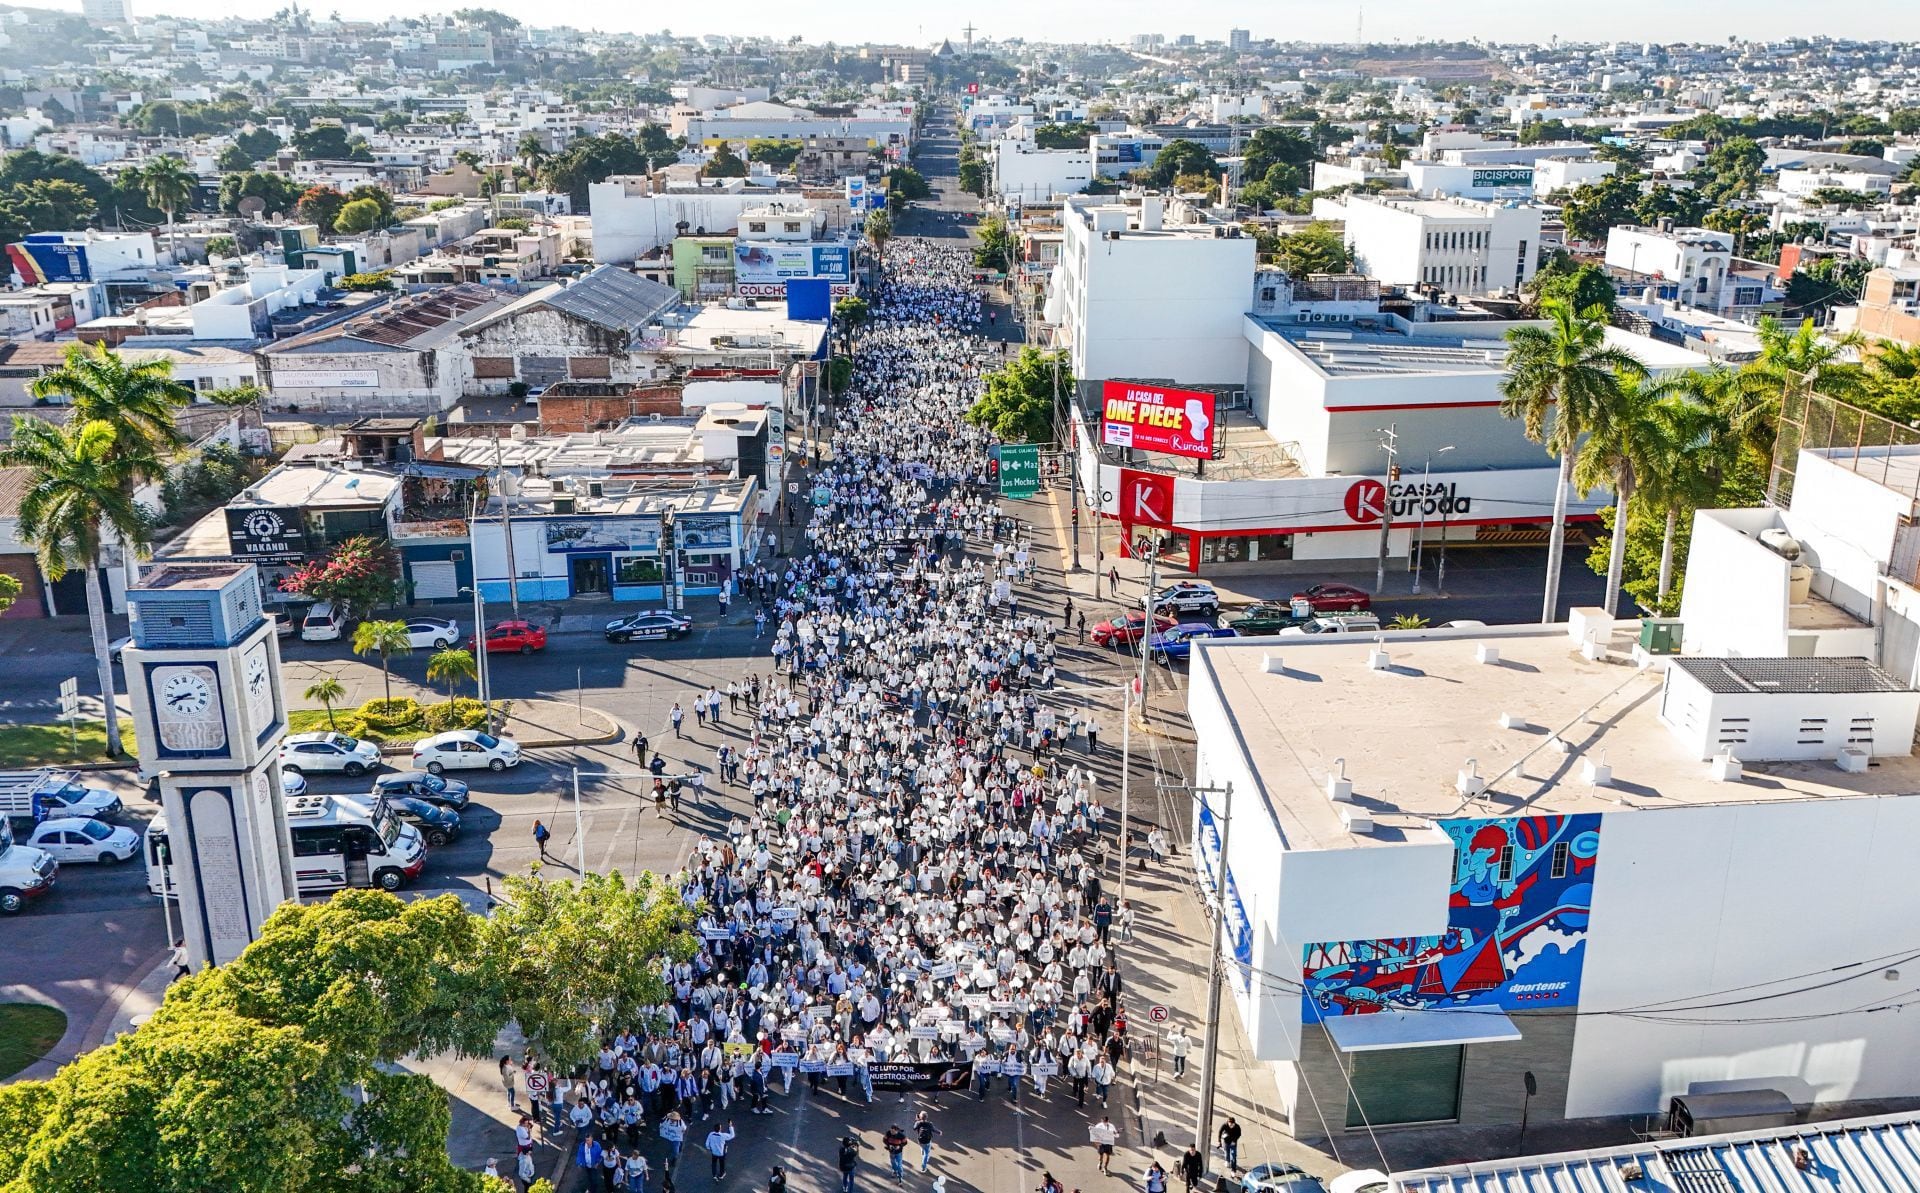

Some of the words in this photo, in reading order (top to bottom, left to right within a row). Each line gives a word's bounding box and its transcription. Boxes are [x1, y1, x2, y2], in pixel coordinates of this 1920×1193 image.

[1473, 170, 1532, 180] BICISPORT
[1127, 389, 1134, 401] LA
[1135, 391, 1152, 403] CASA
[1152, 393, 1165, 405] DEL
[1106, 399, 1136, 423] ONE
[1138, 402, 1184, 429] PIECE
[1172, 436, 1209, 453] Kuroda
[1001, 478, 1013, 486] Los
[1014, 477, 1036, 486] Mochis
[1389, 482, 1445, 498] CASA
[1357, 482, 1471, 519] Kuroda
[246, 543, 289, 552] VAKANDI
[1508, 981, 1567, 993] dportenis
[899, 1065, 915, 1073] POR
[869, 1072, 906, 1081] NUESTROS
[907, 1072, 931, 1081] NIÑOS
